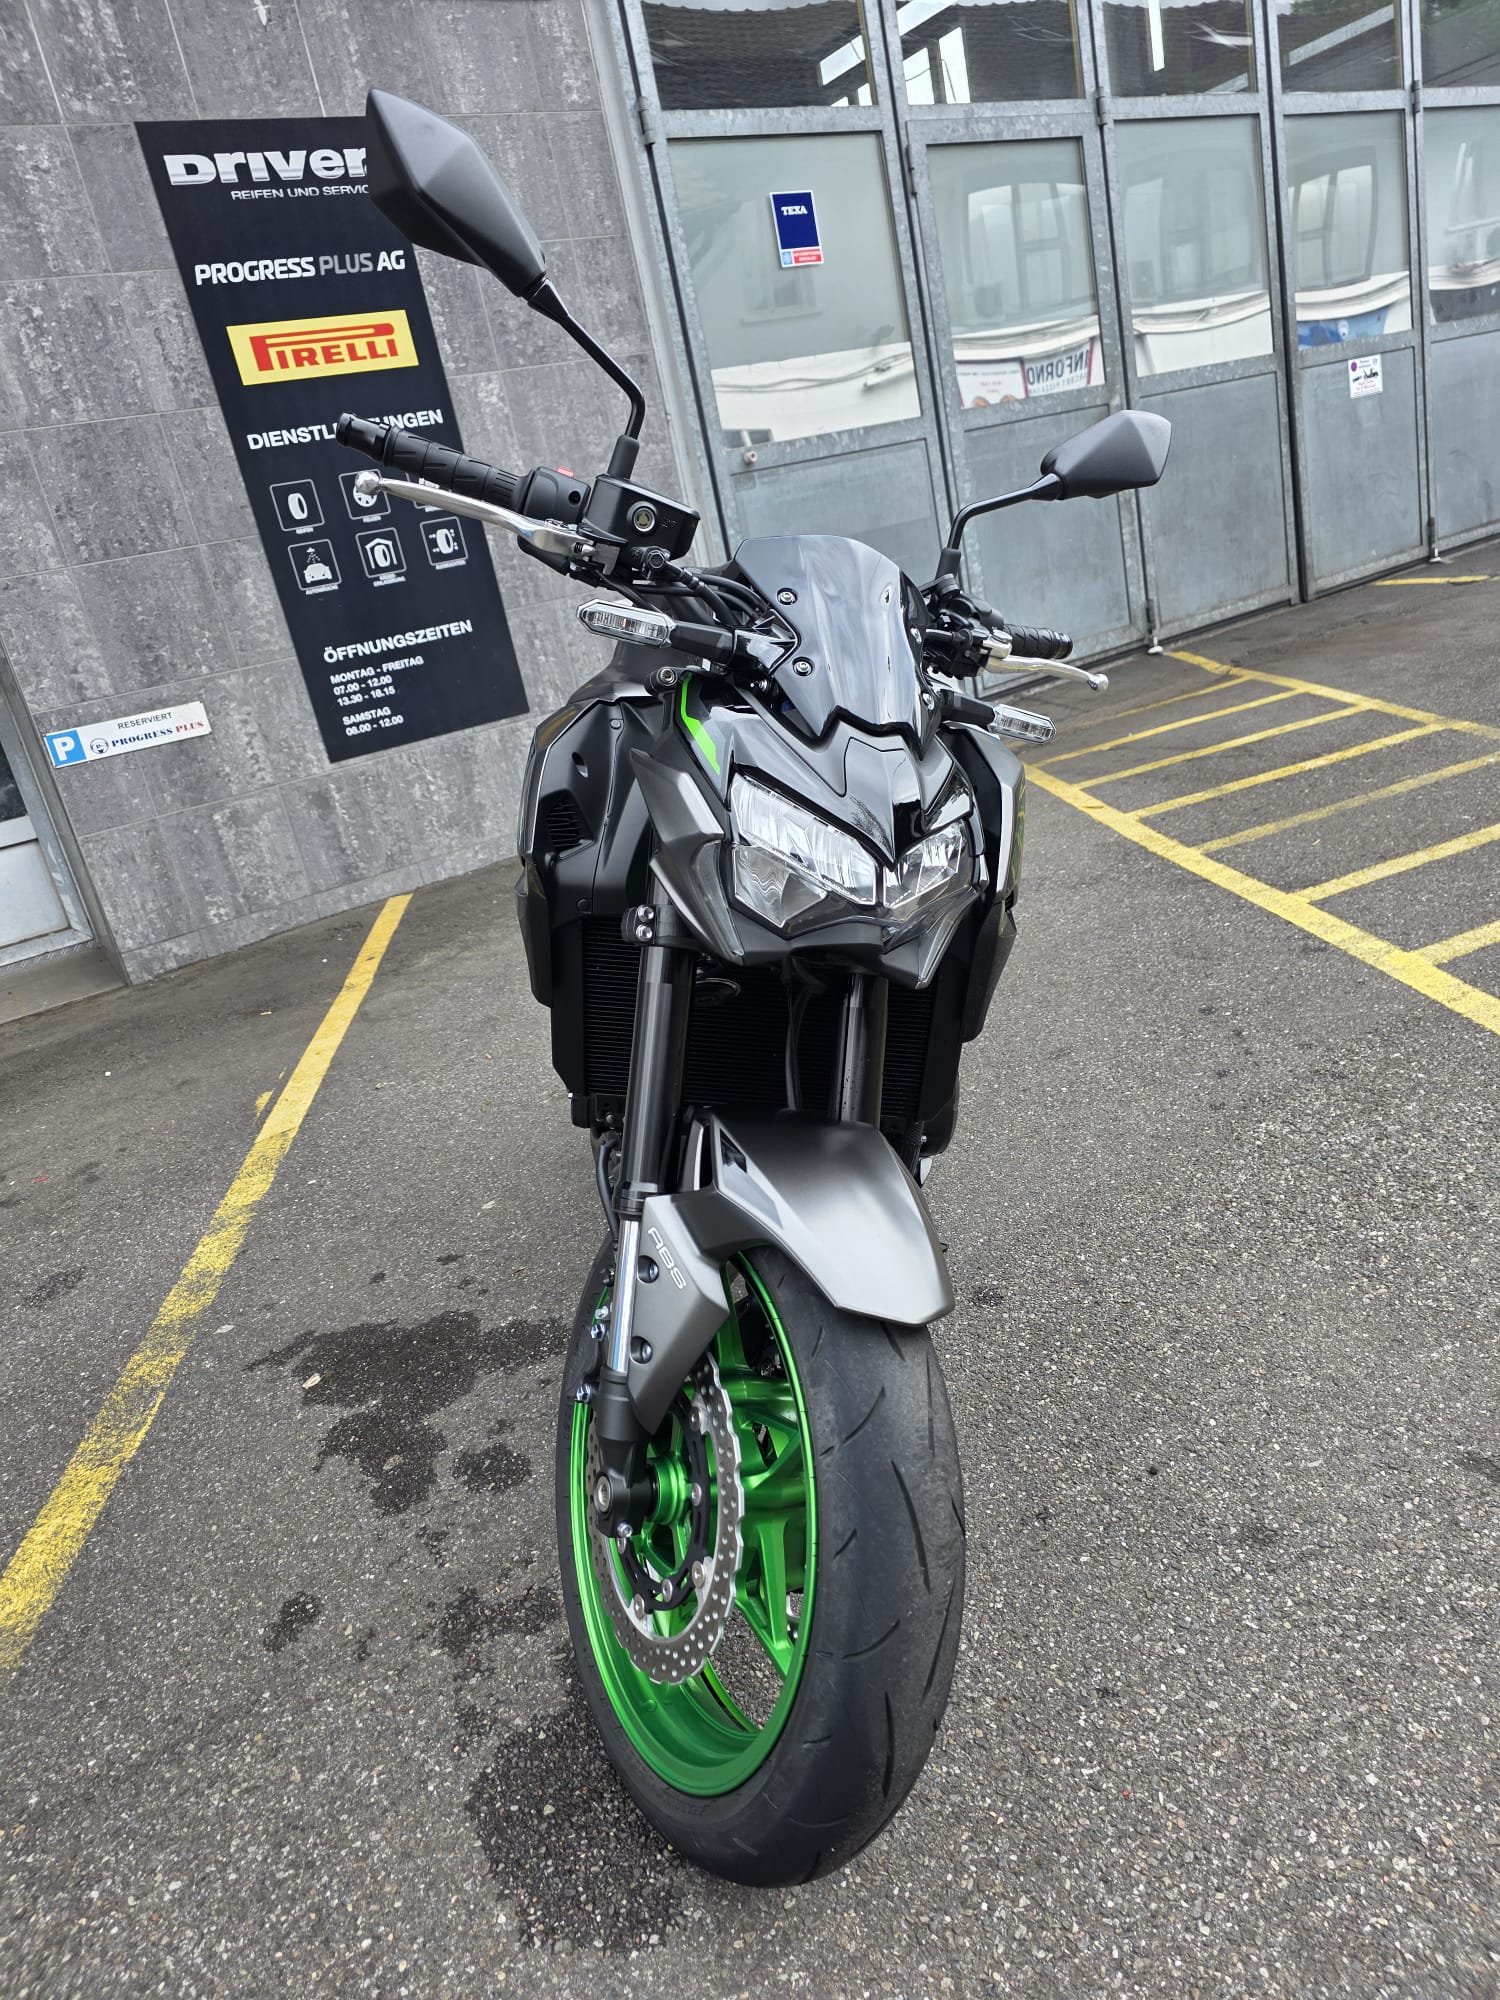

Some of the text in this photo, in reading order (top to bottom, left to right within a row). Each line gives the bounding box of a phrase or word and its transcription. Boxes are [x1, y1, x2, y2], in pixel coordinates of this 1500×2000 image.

[231, 184, 369, 200] REIFEN UND SERVIC
[781, 205, 808, 216] TEXA
[194, 250, 406, 286] PROGRESS PLUS AG
[249, 322, 399, 372] PIRELLI
[246, 408, 444, 450] DIENSTLNGEN
[323, 619, 473, 664] ÖFFNUNGSZEITEN
[329, 666, 376, 684] MONTAG
[382, 655, 425, 673] FREITAG
[333, 682, 360, 696] 07.00
[366, 674, 393, 688] 12.00
[337, 693, 364, 707] 13.30
[370, 685, 396, 699] 18.15
[117, 711, 173, 730] RESERVIERT
[342, 706, 392, 726] SAMSTAG
[345, 722, 372, 737] 08.00
[378, 714, 404, 729] 12.00
[111, 727, 173, 748] PROGRESS
[175, 720, 205, 733] PLUS
[52, 735, 76, 762] P
[647, 1226, 687, 1290] ABS
